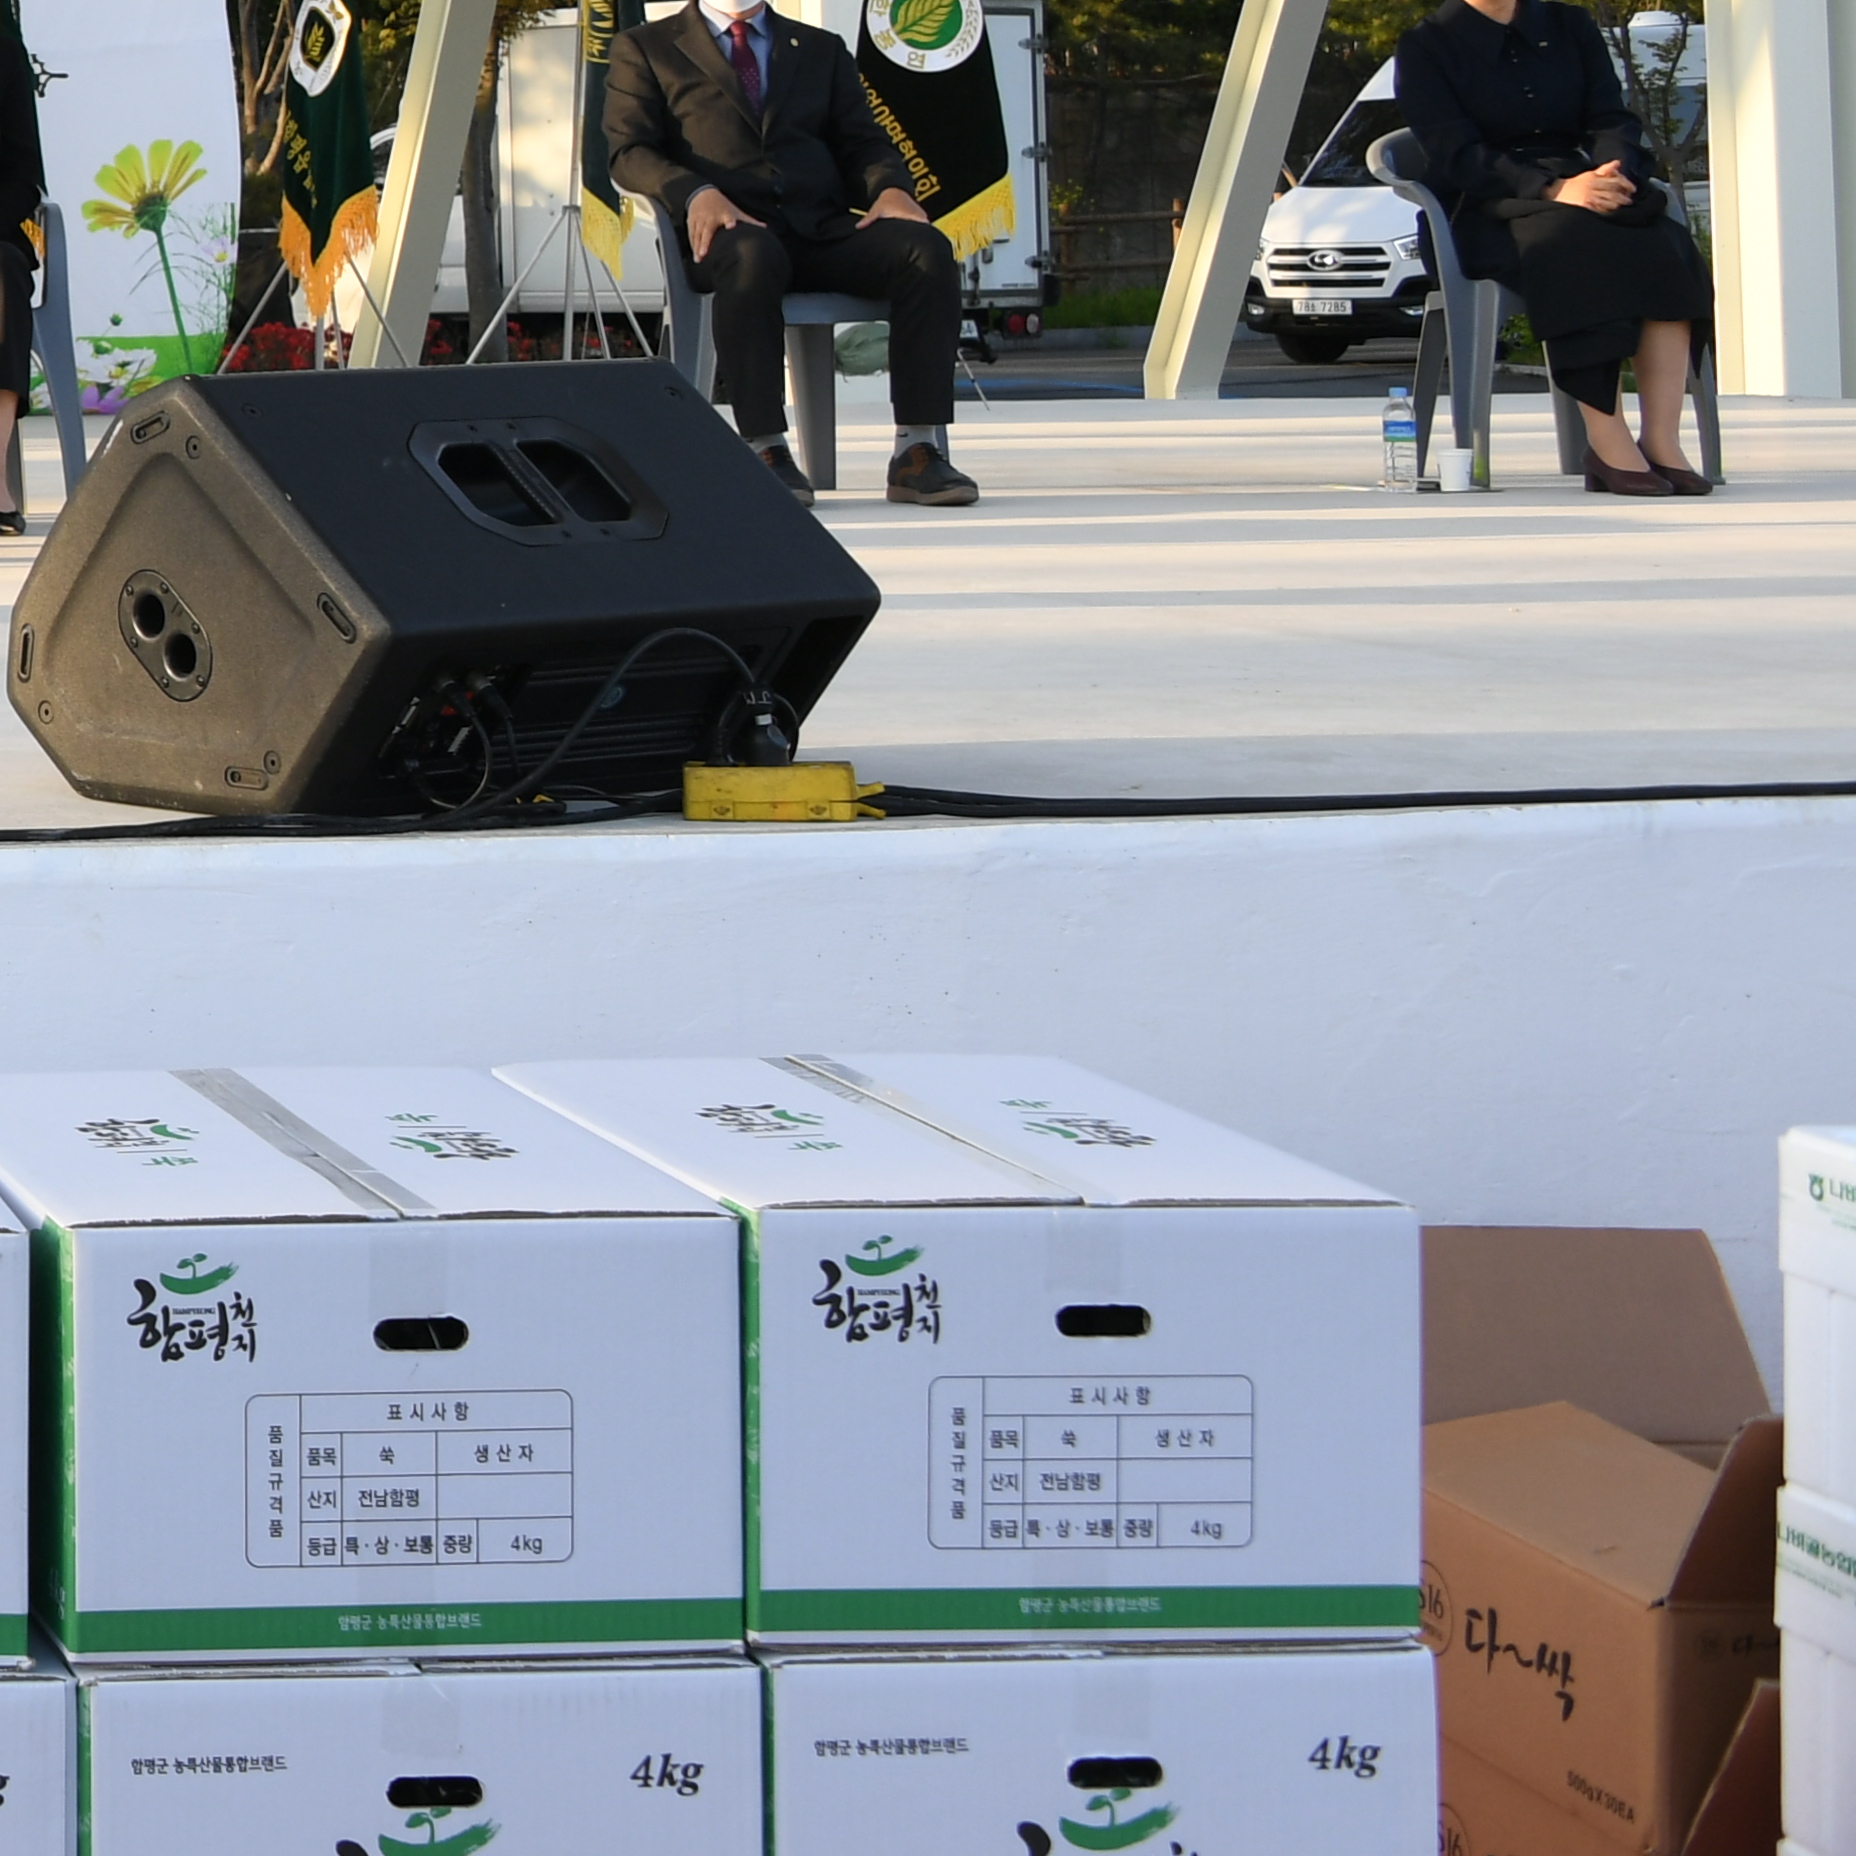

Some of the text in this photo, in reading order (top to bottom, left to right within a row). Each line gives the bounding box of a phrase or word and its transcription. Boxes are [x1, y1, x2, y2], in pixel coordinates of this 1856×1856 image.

[988, 1428, 1021, 1450] 품목
[1060, 1428, 1078, 1449] 쑥
[306, 1446, 338, 1467] 품목
[378, 1445, 397, 1465] 쑥
[988, 1470, 1103, 1493] 산지 전남함평
[306, 1487, 421, 1510] 산지 전남함평
[987, 1517, 1019, 1539] 등급
[1122, 1517, 1154, 1540] 중량
[1189, 1516, 1224, 1540] 4kg
[306, 1535, 338, 1557] 등급
[442, 1533, 474, 1556] 중량
[509, 1533, 544, 1556] 4kg
[1307, 1734, 1383, 1782] 4kg
[628, 1752, 705, 1799] 4kg
